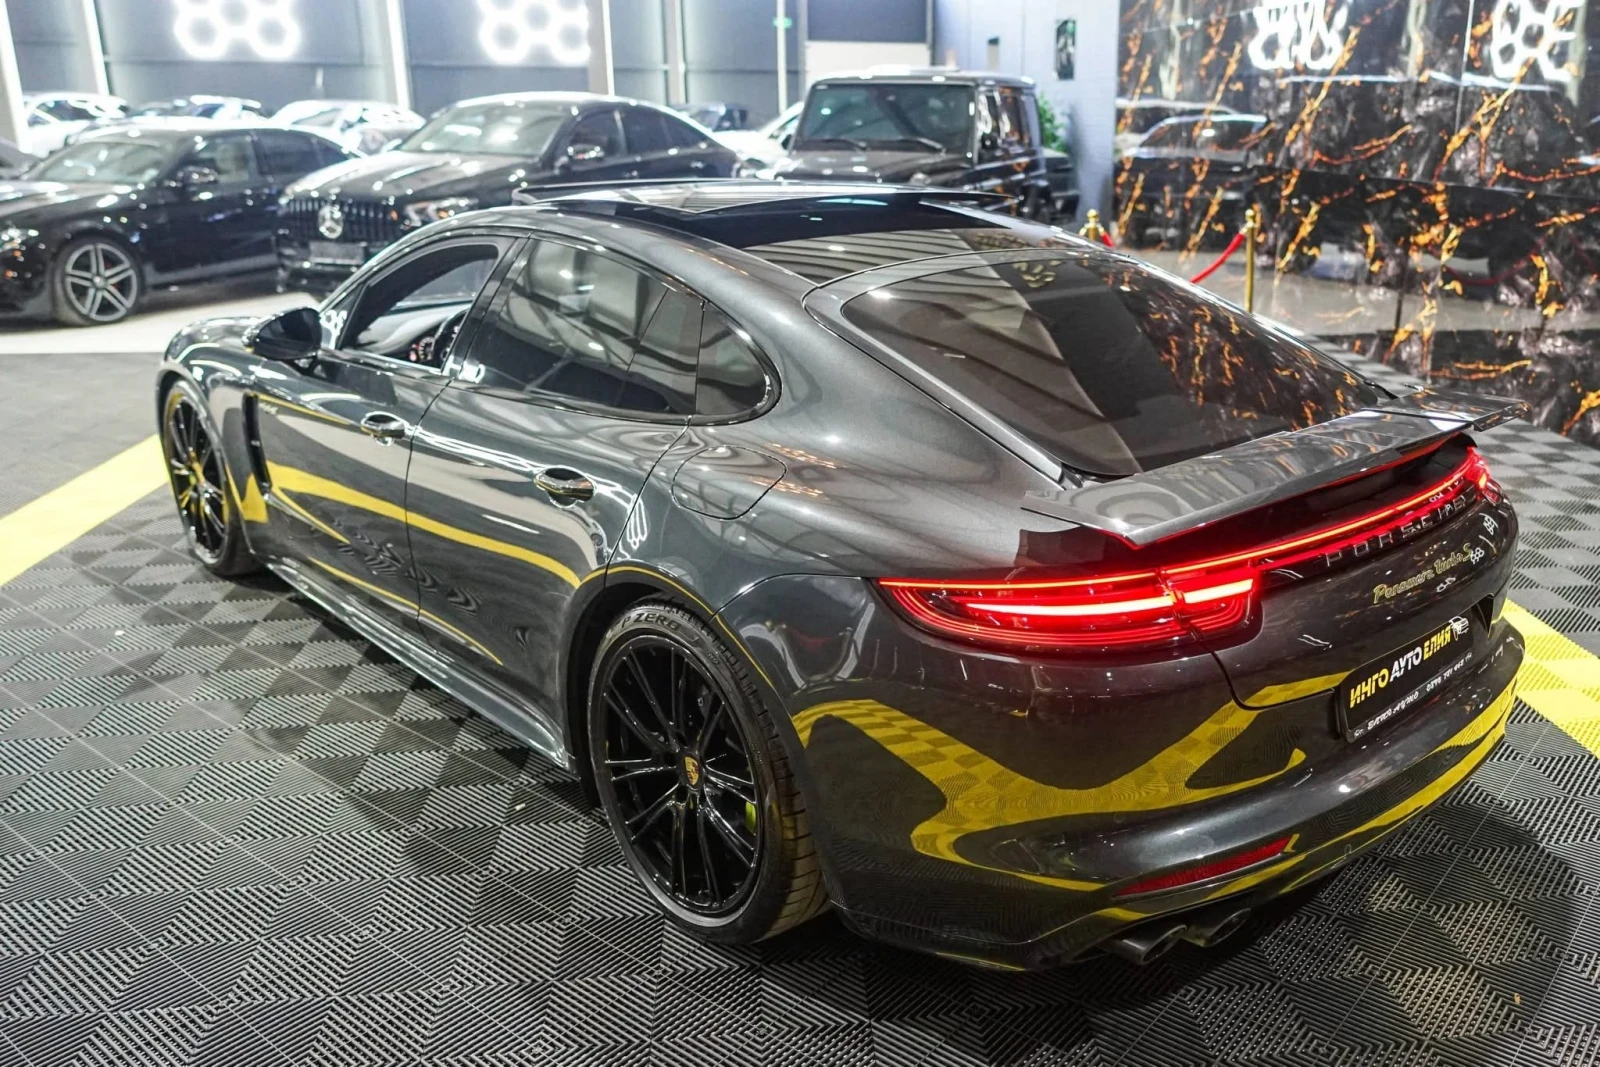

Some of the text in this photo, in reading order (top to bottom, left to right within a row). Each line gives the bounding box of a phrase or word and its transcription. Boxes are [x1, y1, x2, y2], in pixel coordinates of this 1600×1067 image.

[1325, 493, 1466, 567] PORSCHE
[1462, 542, 1473, 563] S
[621, 613, 682, 632] P ZERO
[1350, 624, 1451, 709] ИНГО АУТО ЕЛИЯ
